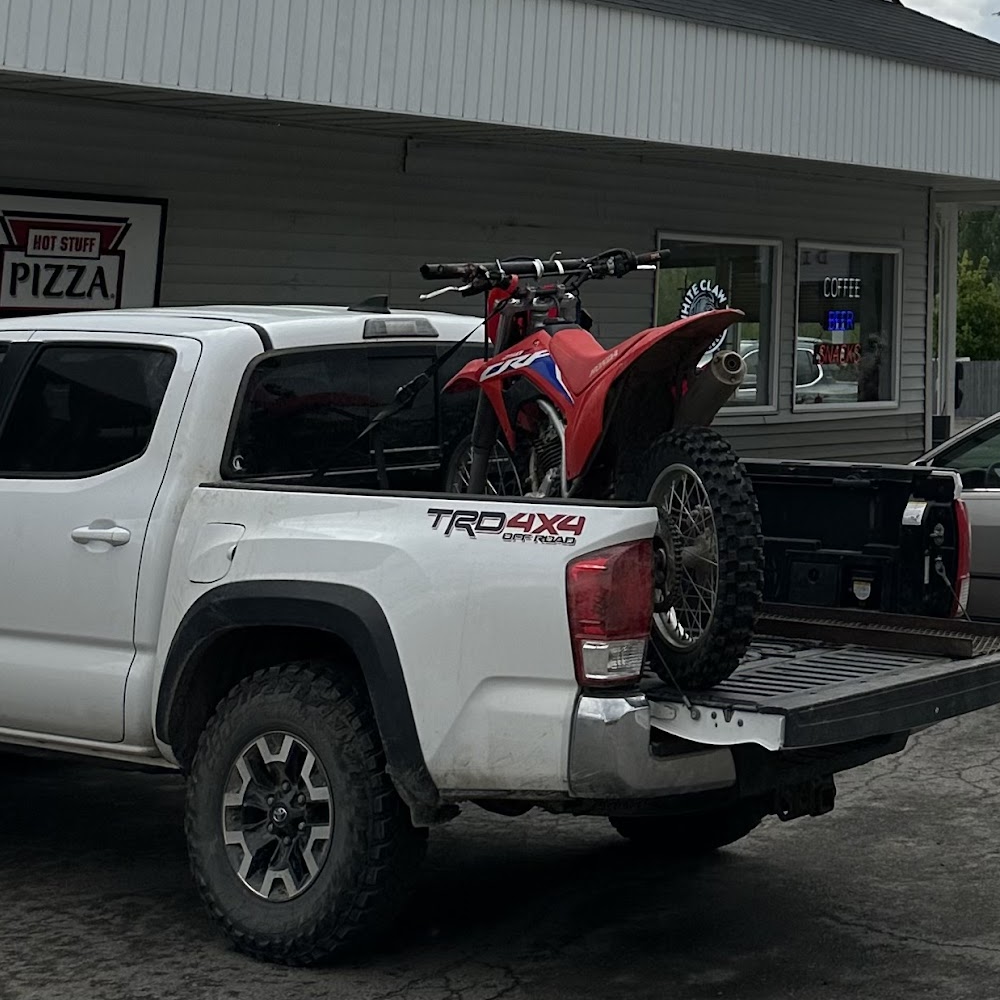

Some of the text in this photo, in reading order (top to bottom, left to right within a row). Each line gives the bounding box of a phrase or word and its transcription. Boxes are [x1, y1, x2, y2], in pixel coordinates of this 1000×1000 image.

[33, 235, 97, 253] HOT STUFF
[9, 262, 110, 298] PIZZA
[823, 277, 861, 298] COFFEE
[680, 279, 728, 320] HITE CLAW
[828, 311, 855, 331] BEER
[818, 344, 862, 366] SNACKS
[502, 532, 577, 546] OFF ROAD
